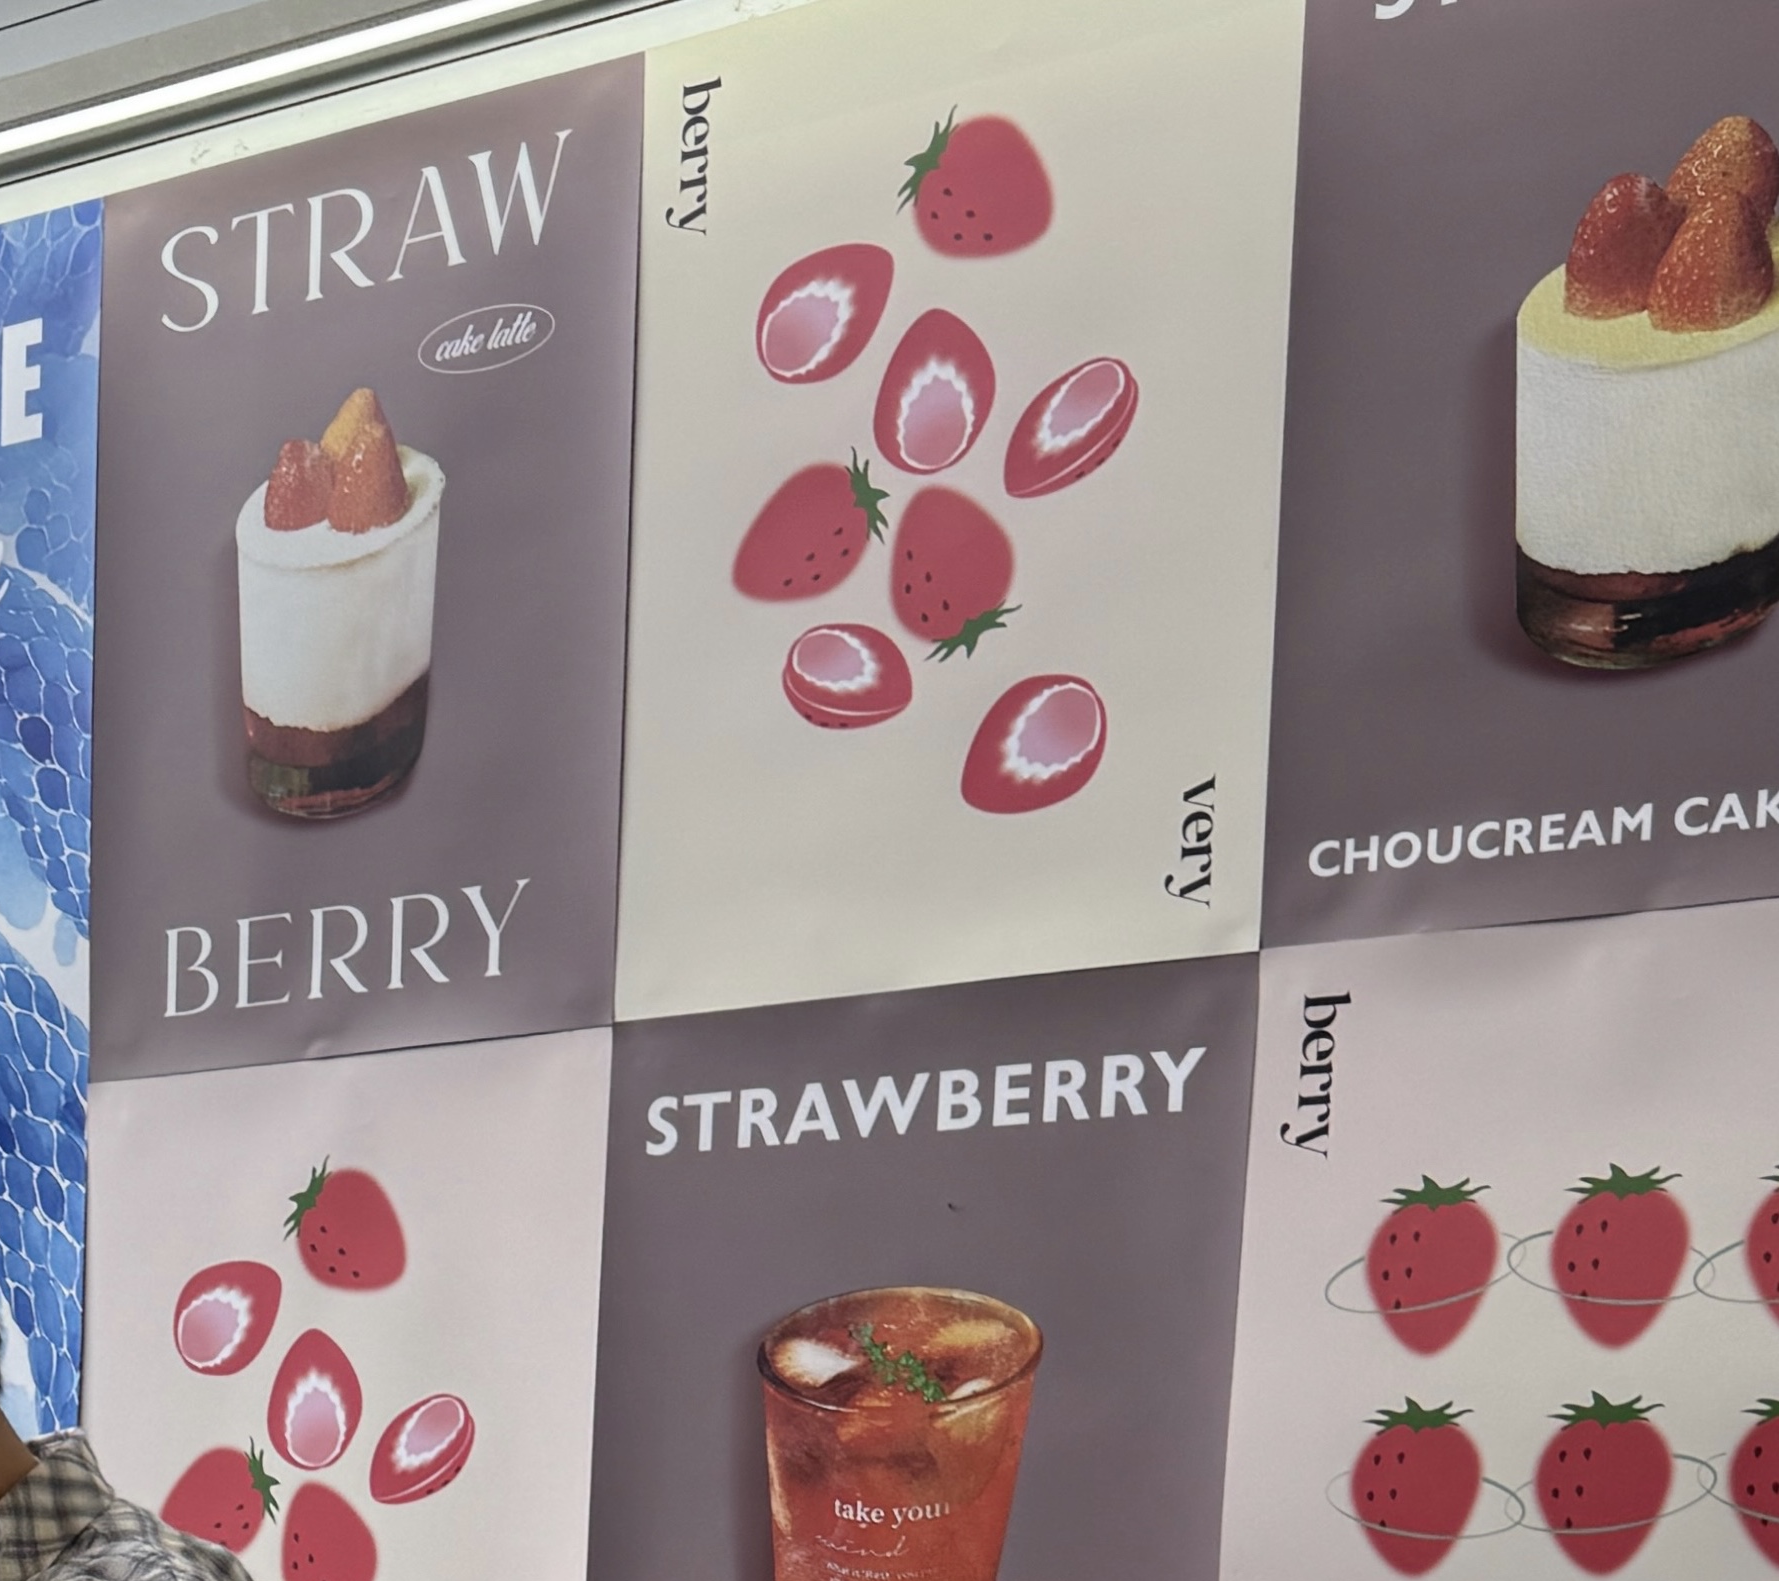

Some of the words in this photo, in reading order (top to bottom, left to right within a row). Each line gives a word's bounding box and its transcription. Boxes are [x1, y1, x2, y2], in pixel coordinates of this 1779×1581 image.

[666, 76, 722, 236] berry
[161, 129, 573, 333] STRAW
[435, 324, 485, 362] cake
[486, 311, 537, 350] latte
[1164, 773, 1216, 909] very
[1308, 803, 1653, 877] CHOUCREAM
[164, 878, 531, 1018] BERRY
[645, 1047, 1207, 1156] STRAWBERRY
[1280, 990, 1352, 1160] berry
[834, 1498, 886, 1524] take
